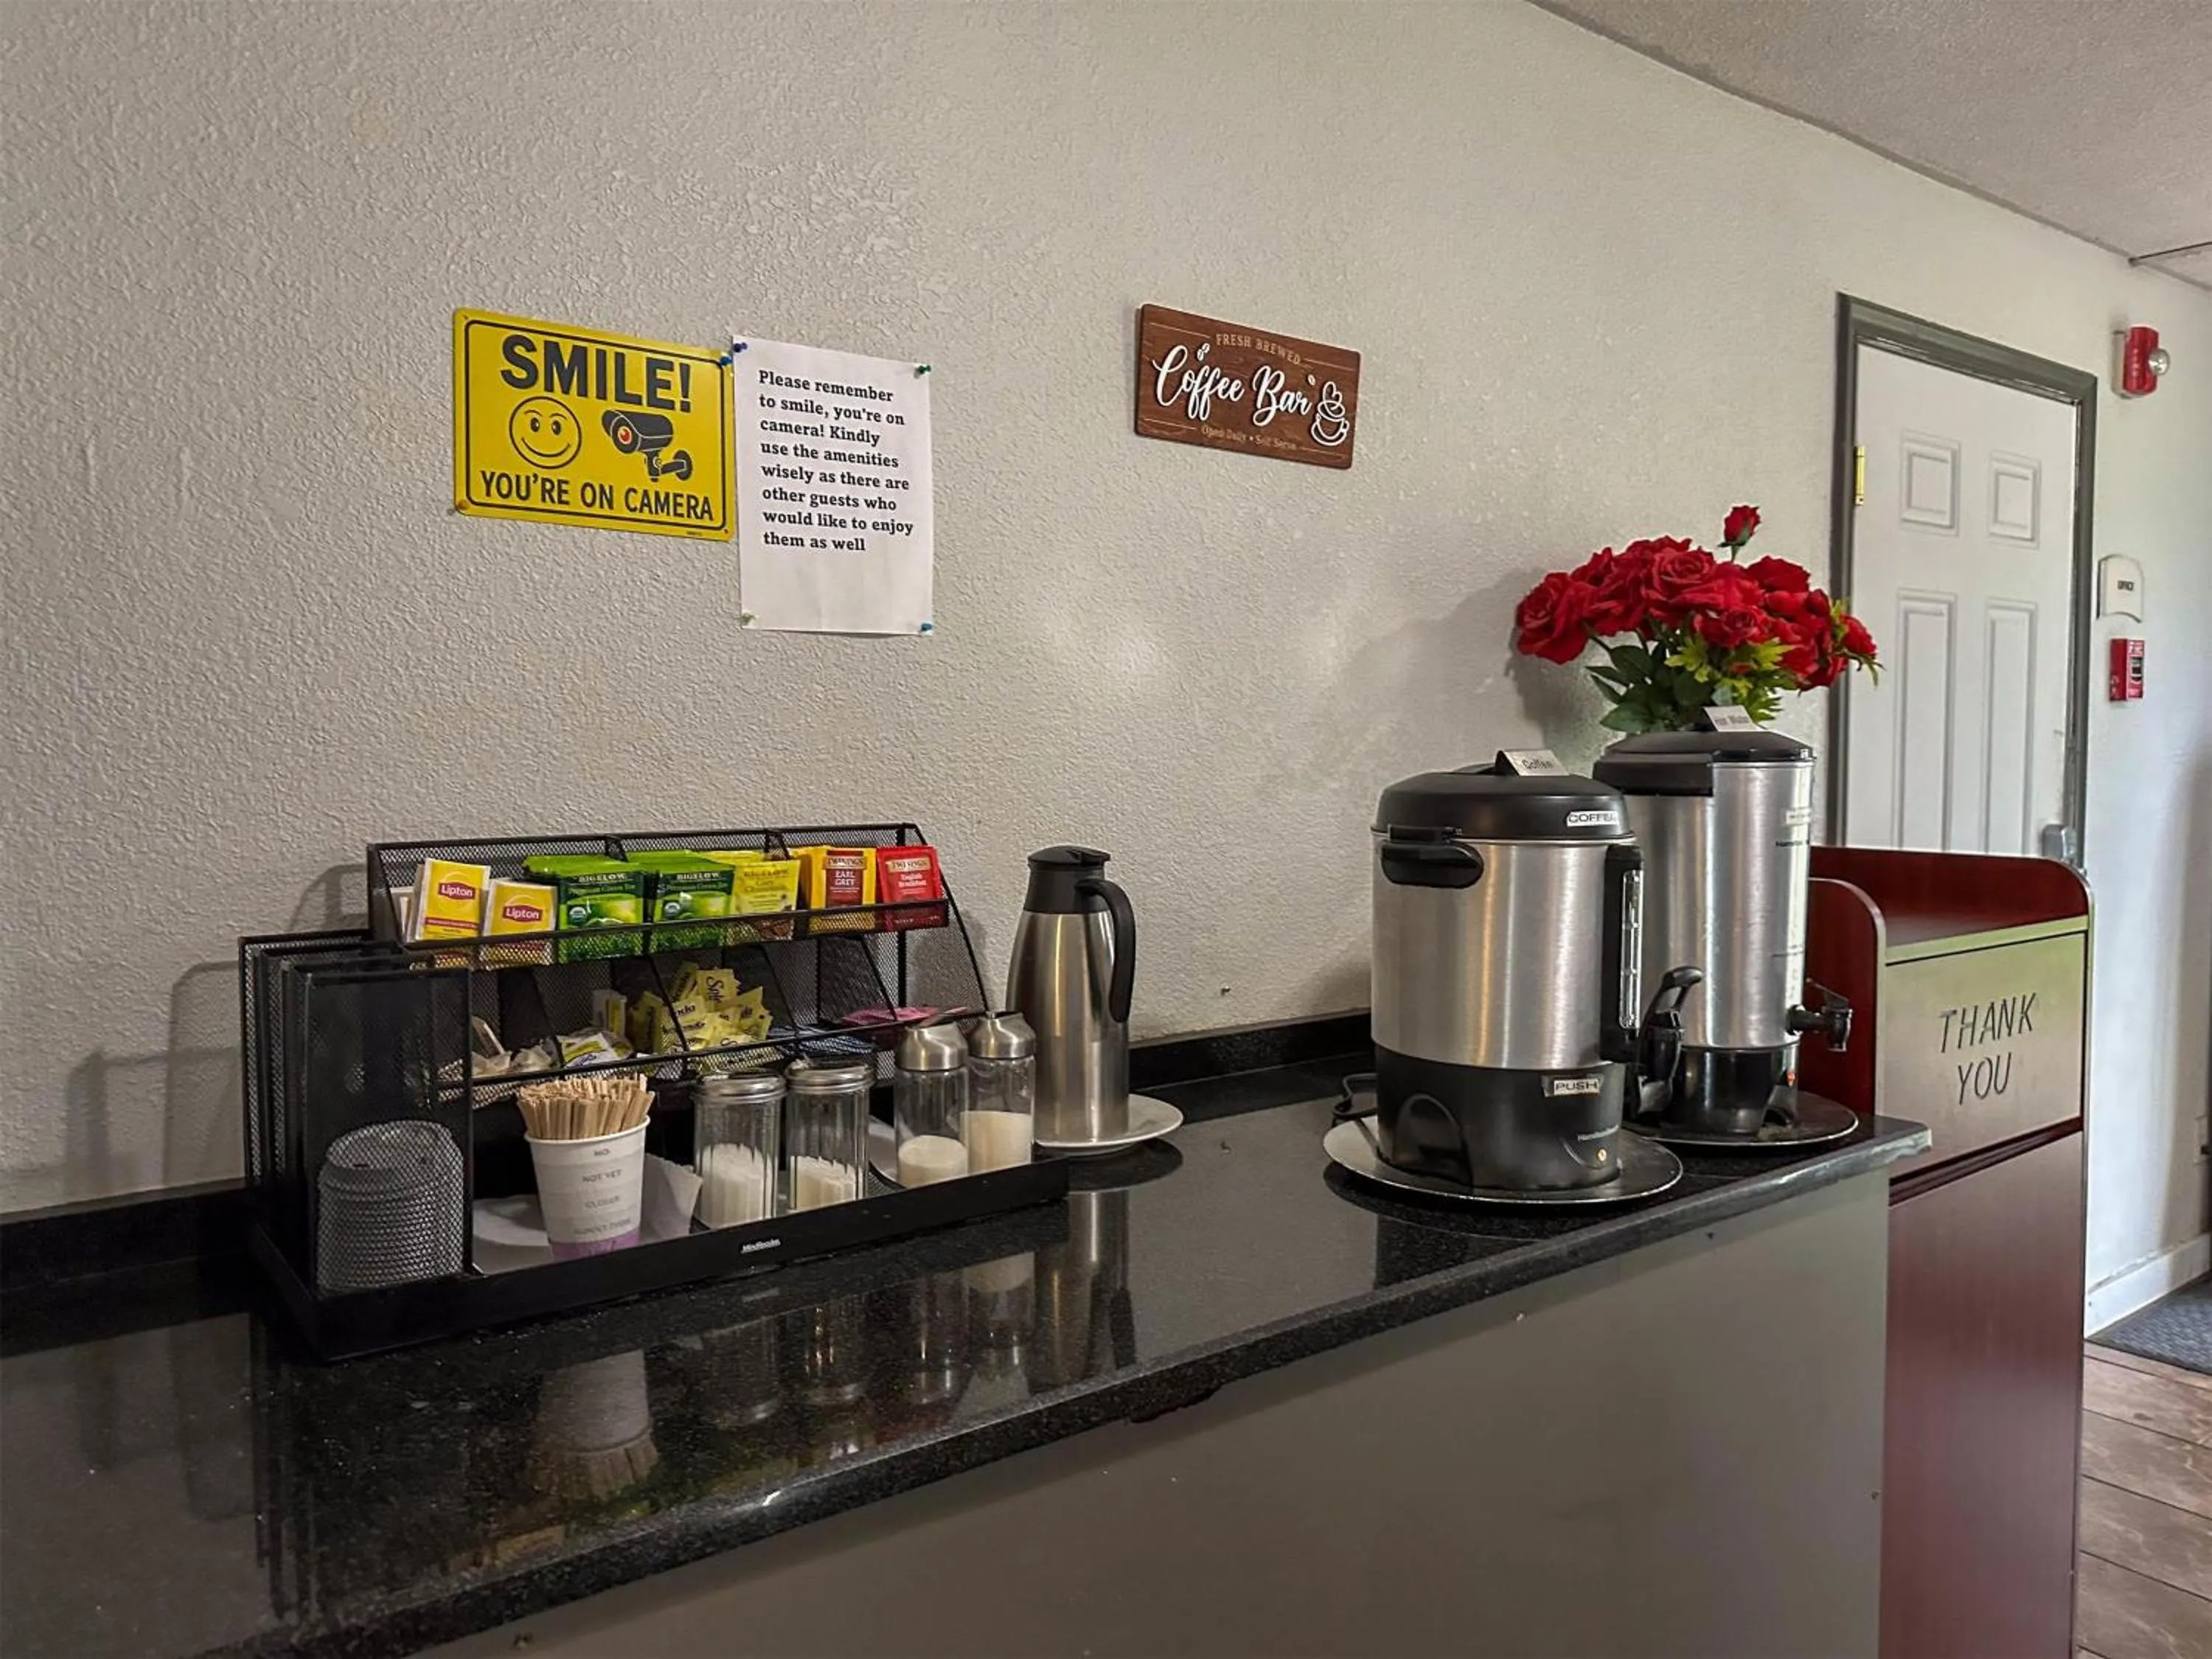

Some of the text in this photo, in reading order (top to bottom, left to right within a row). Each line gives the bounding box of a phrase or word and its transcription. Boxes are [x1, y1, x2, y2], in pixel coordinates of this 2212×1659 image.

[1216, 334, 1301, 364] FRESH BREWED
[499, 334, 691, 413] SMILE!
[759, 369, 894, 403] Please remember
[1152, 344, 1312, 426] Coffee Bar
[759, 394, 905, 425] to smile, you're on
[760, 420, 880, 448] camera! Kindly
[761, 443, 899, 468] use the amenities
[761, 465, 909, 490] wisely as there are
[480, 470, 714, 521] YOU'RE ON CAMERA
[762, 487, 897, 511] other guests who
[762, 509, 914, 536] would like to enjoy
[763, 532, 866, 552] them as well
[442, 885, 473, 897] Lipton
[506, 908, 540, 919] Lipton
[1938, 992, 2037, 1054] THANK
[1555, 1079, 1599, 1091] PUSH
[1958, 1051, 2012, 1105] YOU
